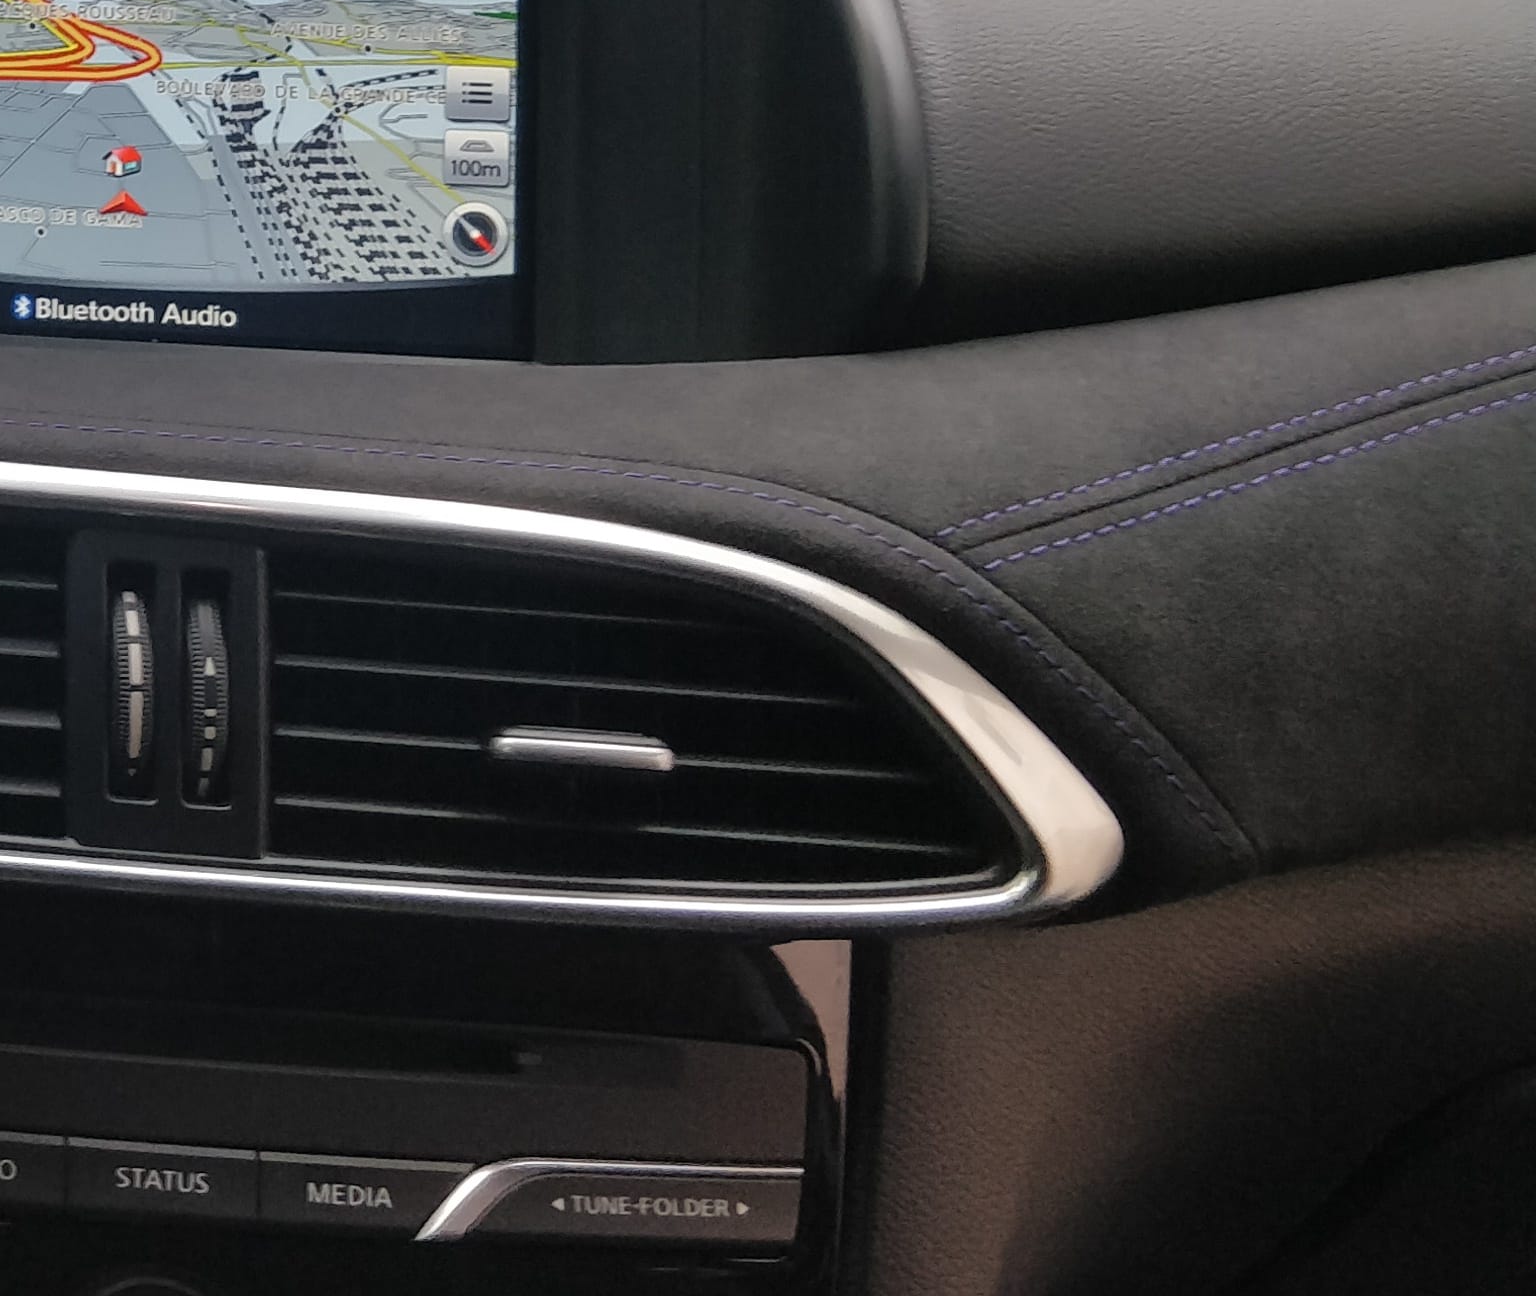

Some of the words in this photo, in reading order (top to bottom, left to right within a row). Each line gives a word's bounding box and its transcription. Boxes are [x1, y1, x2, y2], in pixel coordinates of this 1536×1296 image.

[77, 4, 176, 22] ROUSSEAU
[275, 85, 299, 100] DE
[309, 86, 329, 100] LA
[341, 88, 416, 104] GRANDE
[451, 159, 501, 178] 100m
[50, 208, 78, 225] DE
[35, 296, 156, 324] Bluetooth
[160, 302, 238, 328] Audio
[114, 1166, 211, 1195] STATUS
[305, 1181, 394, 1209] MEDIA
[569, 1194, 731, 1218] TUNE-FOLDER
